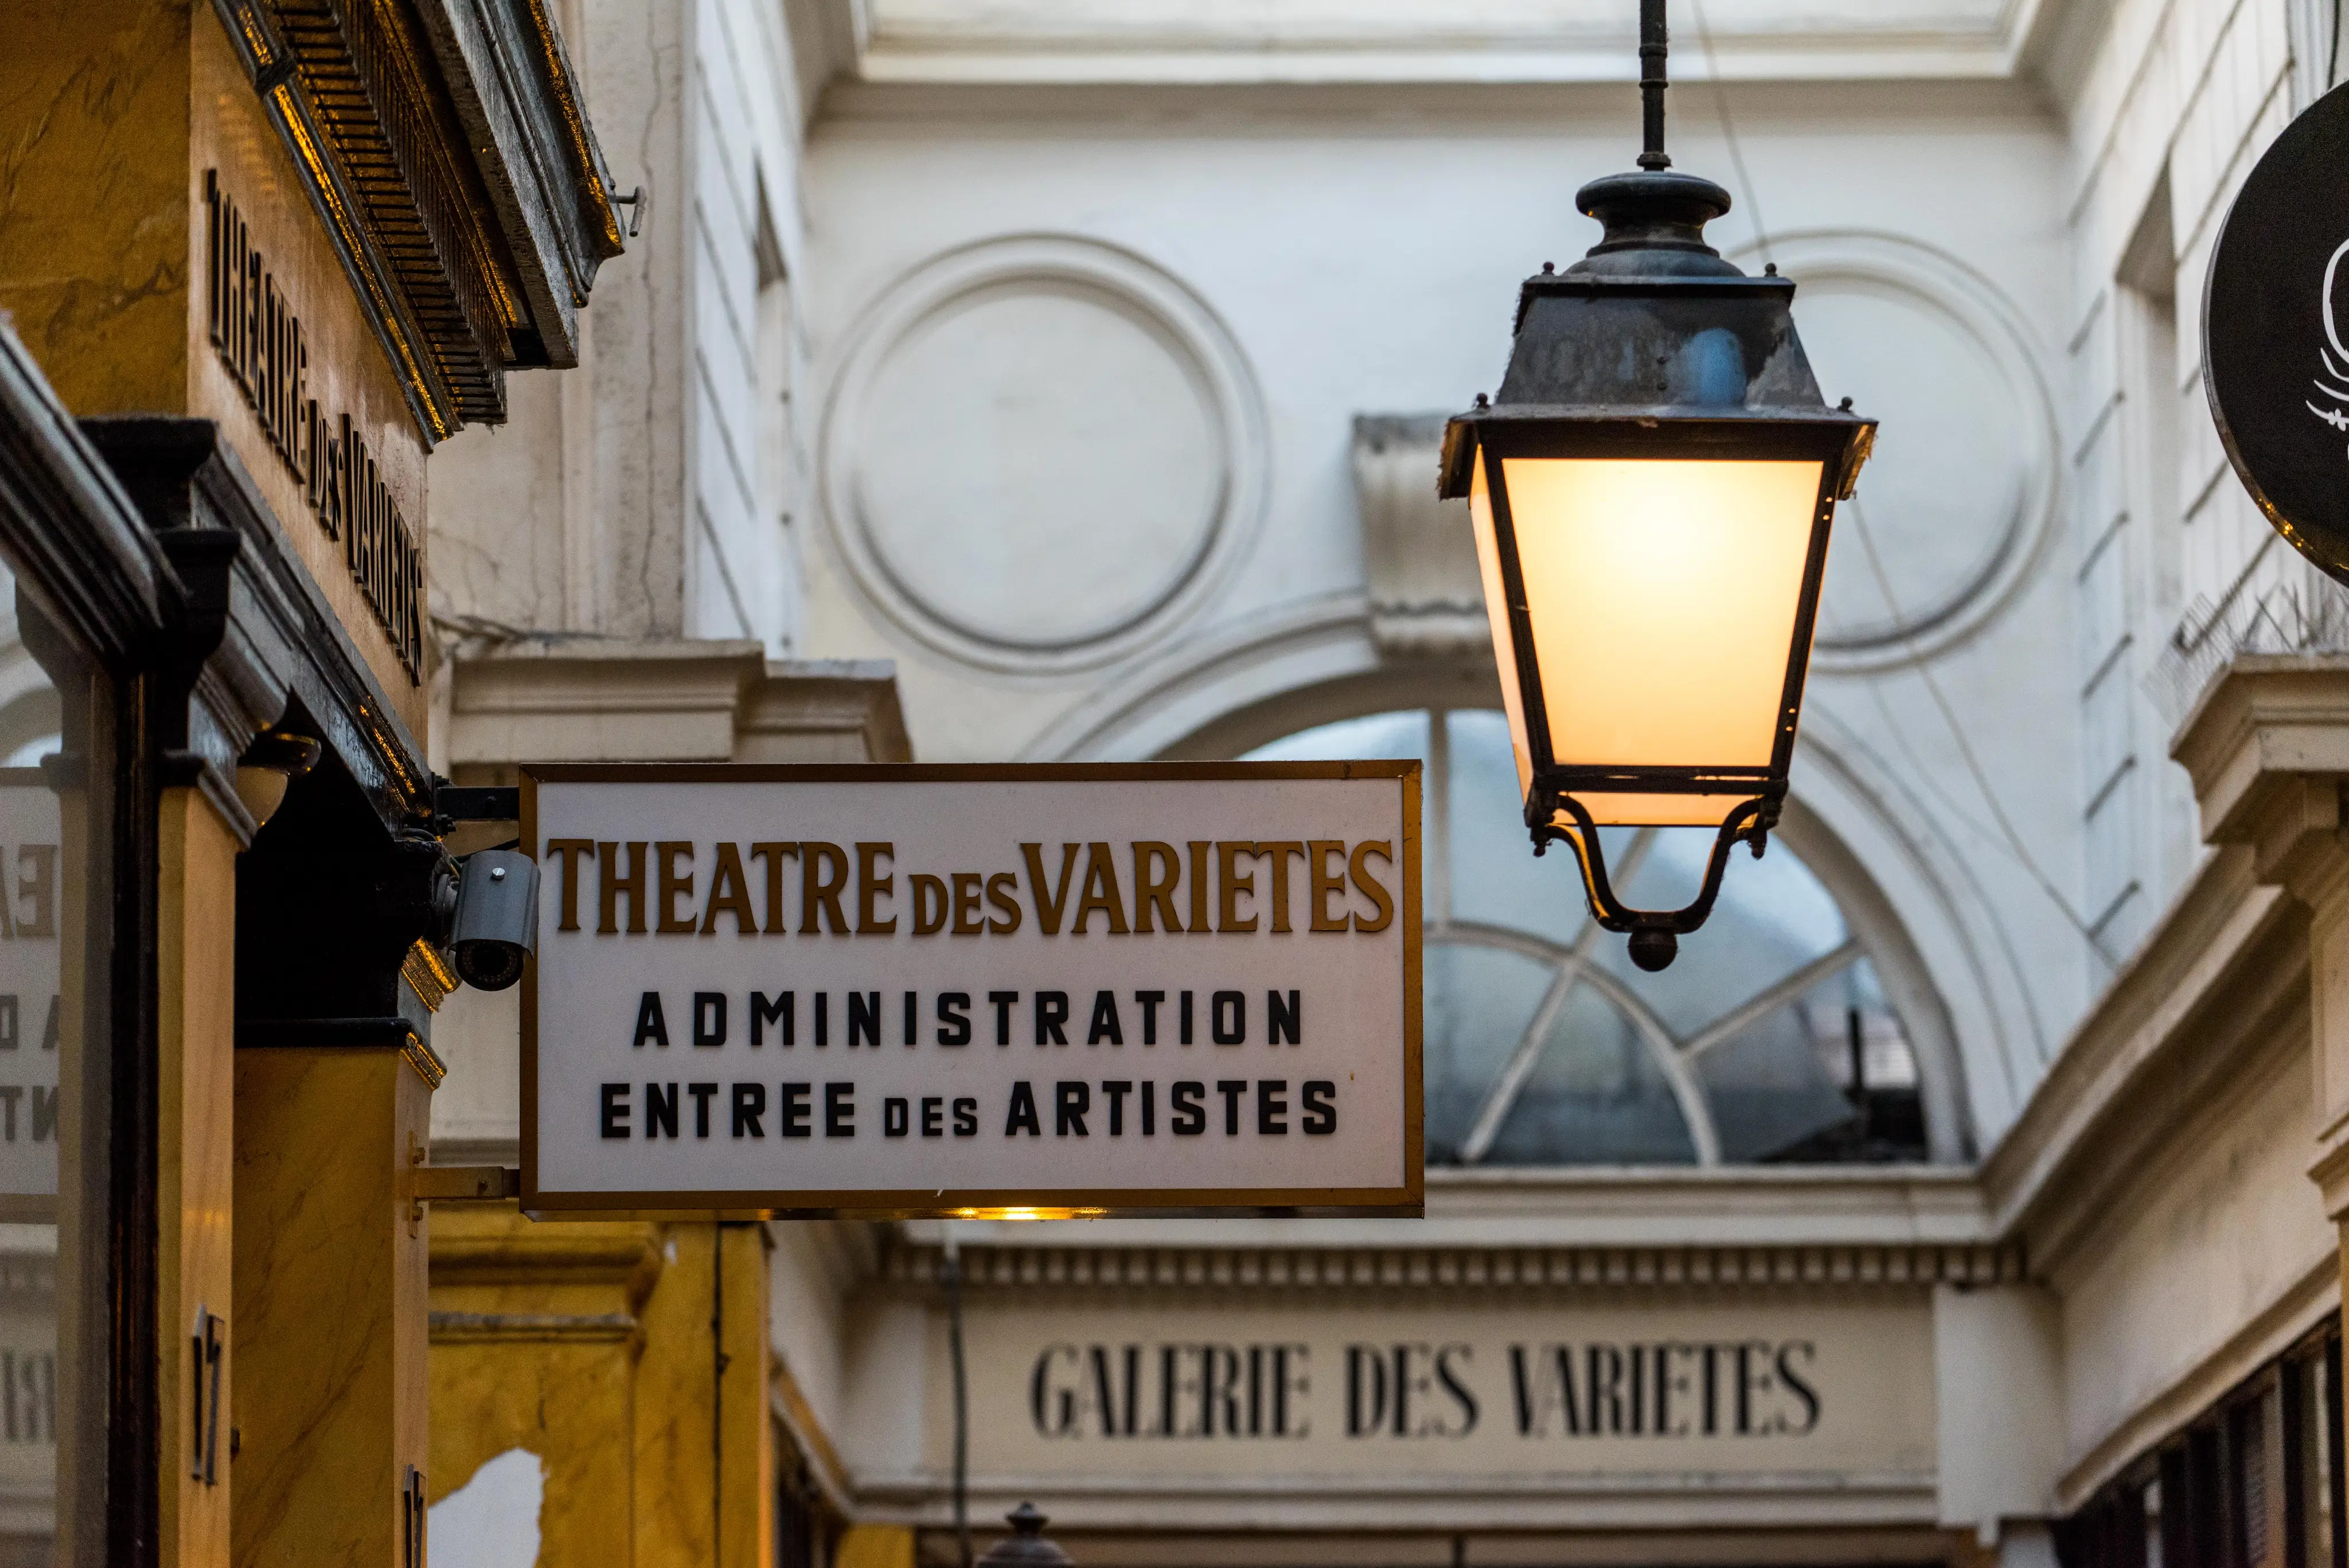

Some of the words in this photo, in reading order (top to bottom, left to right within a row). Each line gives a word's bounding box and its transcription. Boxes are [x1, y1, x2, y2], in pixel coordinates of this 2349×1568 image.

[204, 168, 306, 483] THEATRE
[309, 400, 344, 541] DES
[546, 837, 898, 937] THEATRE
[908, 872, 1023, 938] DES
[1019, 839, 1394, 938] VARIETES
[633, 990, 1301, 1047] ADMINISTRATION
[600, 1082, 856, 1139] ENTREE
[884, 1097, 978, 1138] DES
[1005, 1080, 1337, 1137] ARTISTES
[1029, 1341, 1311, 1439] GALERIE
[1344, 1341, 1480, 1438] DES
